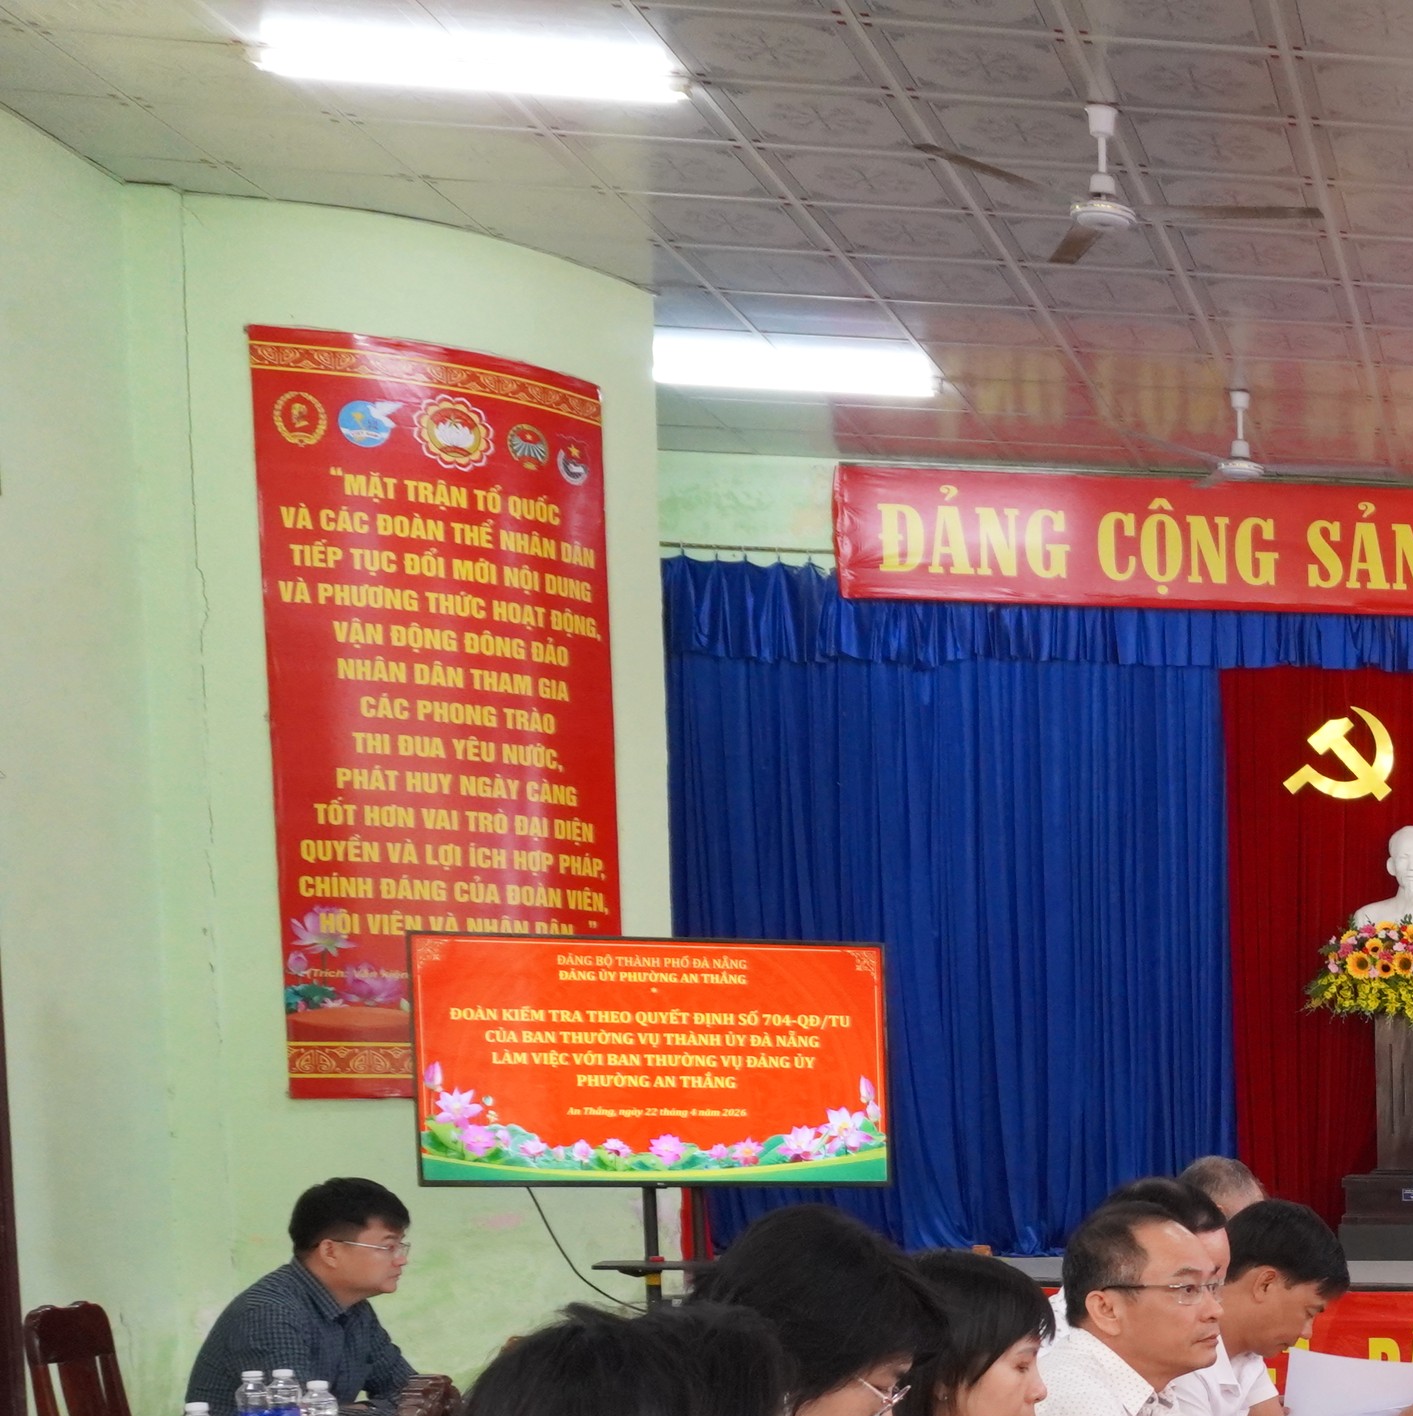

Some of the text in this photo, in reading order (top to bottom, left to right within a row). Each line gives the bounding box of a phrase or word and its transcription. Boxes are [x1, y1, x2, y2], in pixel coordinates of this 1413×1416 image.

[403, 479, 468, 510] TRẬN
[473, 484, 502, 514] TỔ
[508, 495, 560, 526] QUỐC
[280, 503, 595, 569] VÀ CÁC ĐOÀN THỂ NHÂN DÂN
[879, 485, 1068, 580] ĐẢNG
[1098, 498, 1282, 597] CỘNG
[289, 539, 592, 603] TIẾP TỤC ĐỔI MỚI NỘI DUNG
[449, 1005, 850, 1030] ĐOÀN KIỂM TRA THEO QUYẾT ĐỊNH SỐ 704-QĐ/TU
